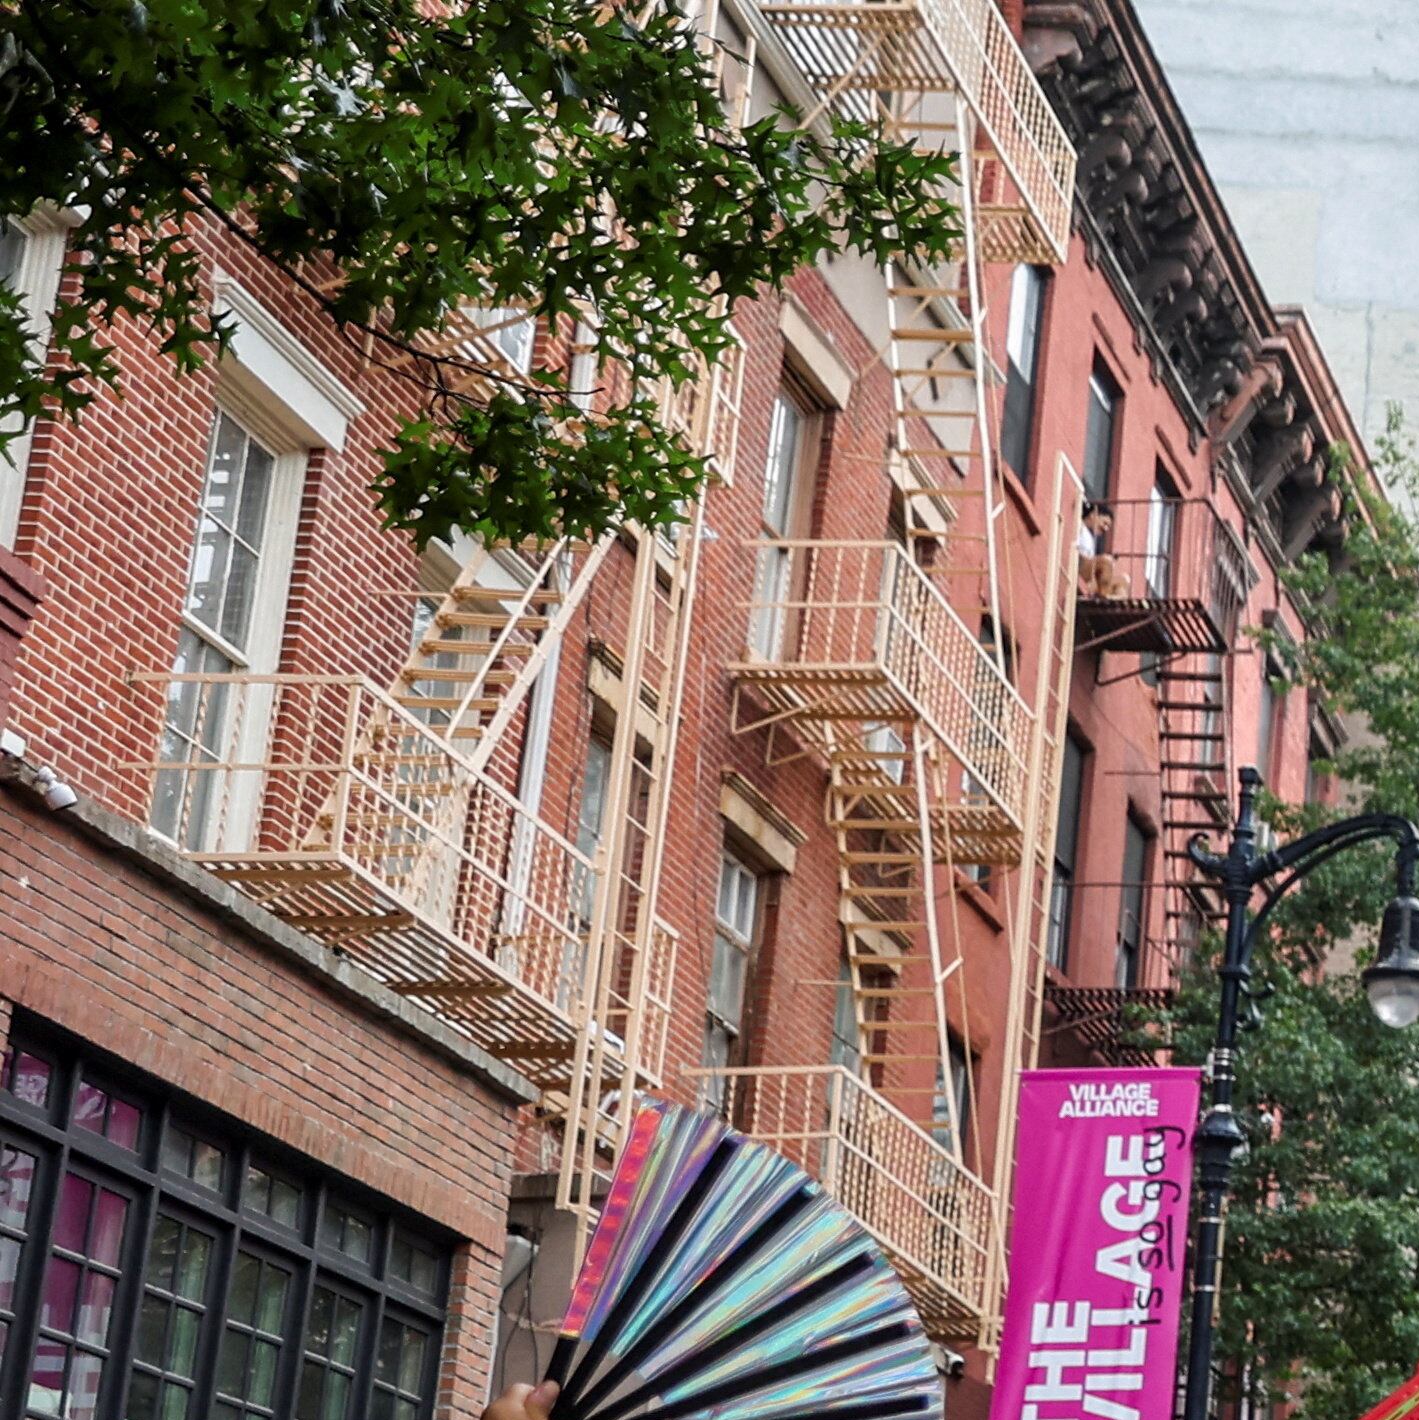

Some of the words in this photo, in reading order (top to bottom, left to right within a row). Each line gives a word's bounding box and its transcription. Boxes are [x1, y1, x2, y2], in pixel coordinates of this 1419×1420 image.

[1058, 1098, 1160, 1118] ALLIANCE
[1069, 1083, 1152, 1101] VILLAGE
[1142, 1125, 1186, 1204] gay
[1138, 1220, 1164, 1270] so
[1129, 1287, 1164, 1326] is
